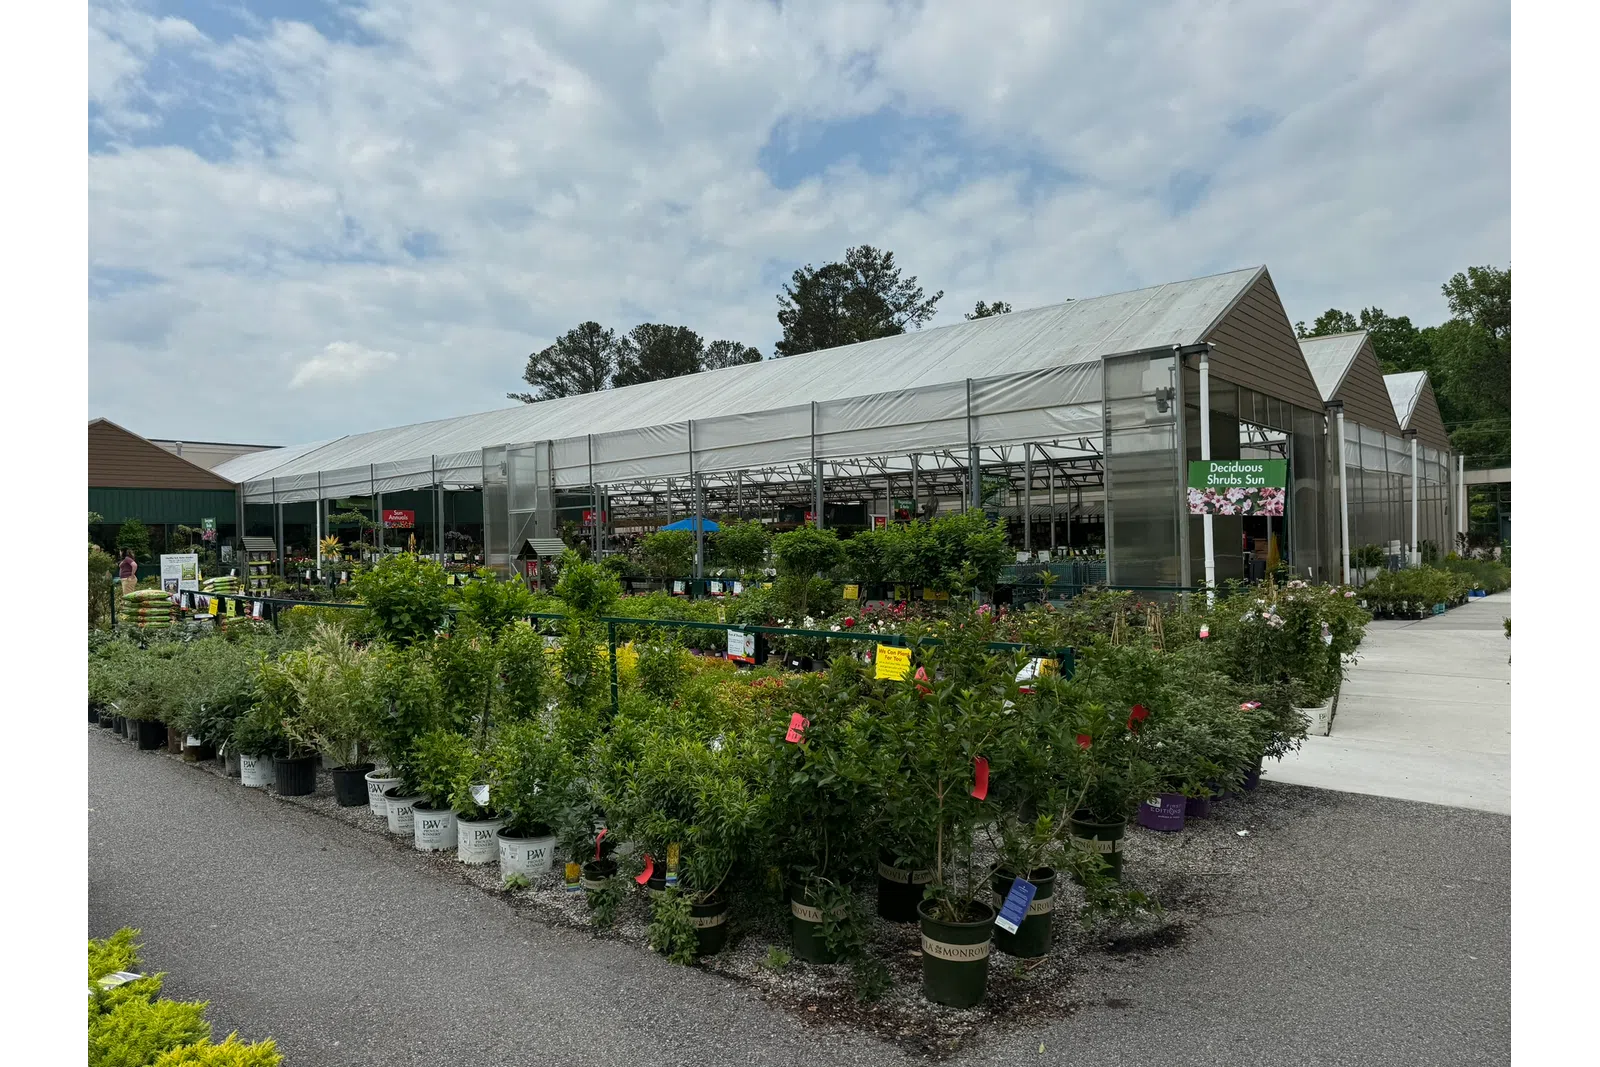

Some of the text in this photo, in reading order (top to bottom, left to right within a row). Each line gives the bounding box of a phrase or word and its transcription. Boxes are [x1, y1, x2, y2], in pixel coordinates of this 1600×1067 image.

[1210, 461, 1263, 473] Deciduous
[1207, 474, 1265, 485] Shrubs Sun
[368, 783, 385, 793] PW
[397, 806, 414, 815] PW
[1150, 807, 1181, 815] EDITIONS
[422, 820, 441, 829] PW
[474, 829, 494, 840] PW
[527, 847, 546, 860] PW
